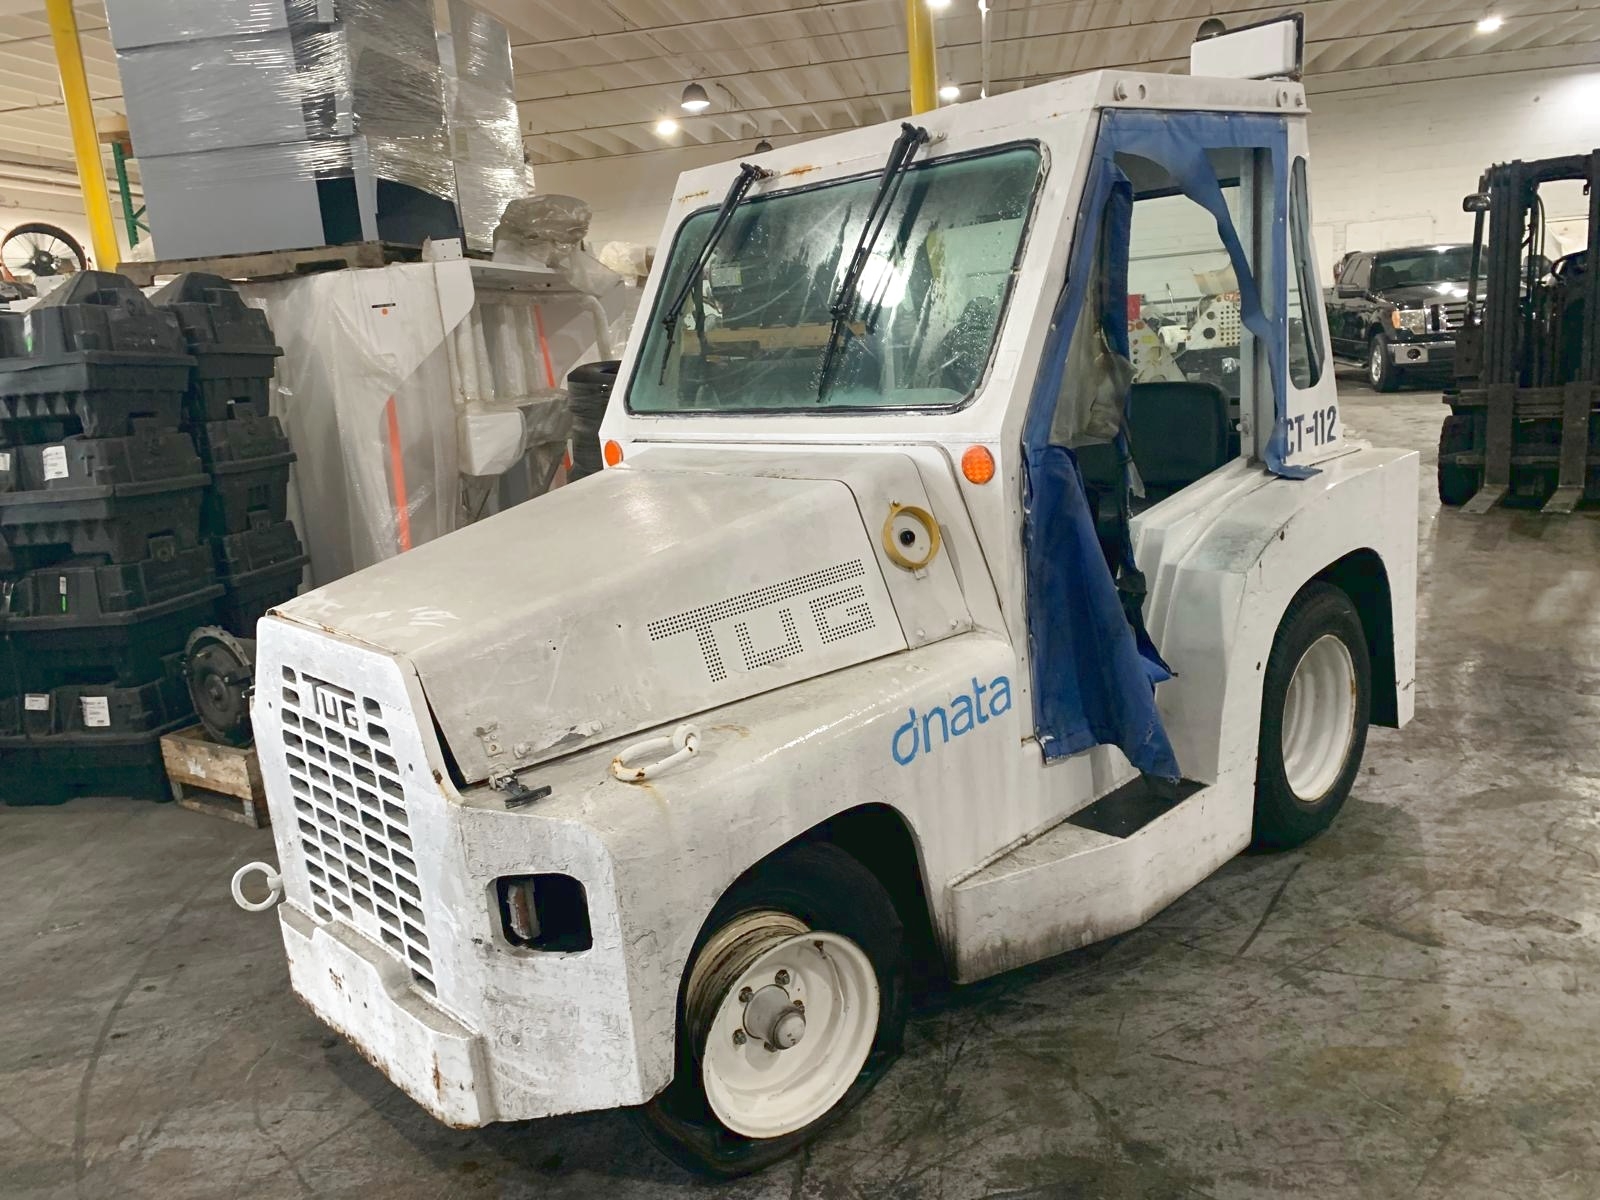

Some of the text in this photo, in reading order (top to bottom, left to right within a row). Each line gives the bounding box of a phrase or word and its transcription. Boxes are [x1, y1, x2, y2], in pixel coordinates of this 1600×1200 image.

[1286, 405, 1337, 456] CT-112
[648, 558, 876, 683] TUG
[301, 672, 360, 732] TUG
[891, 675, 1013, 767] dnata
